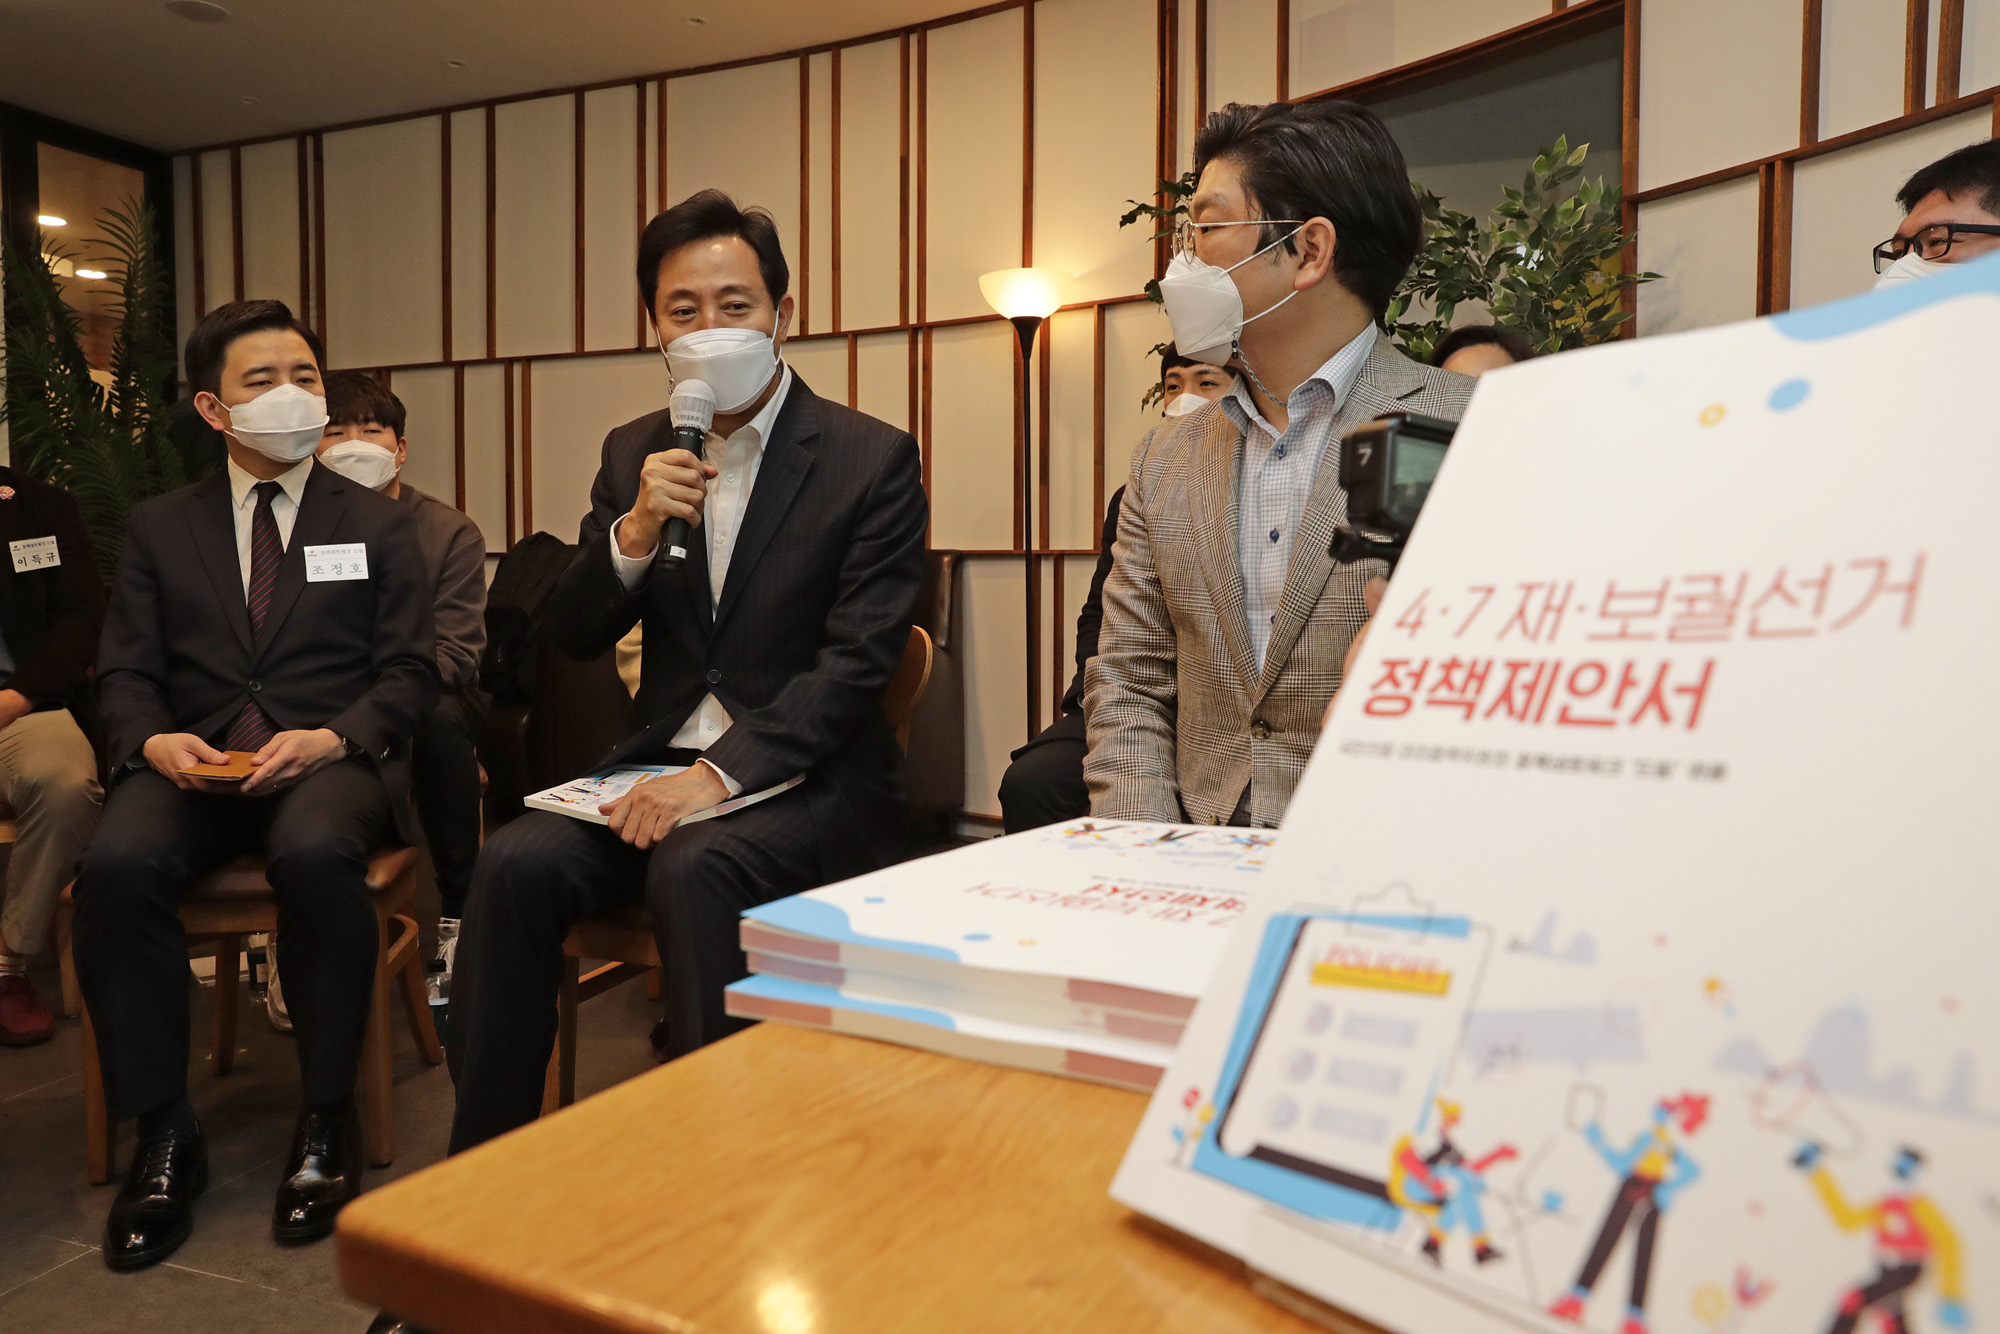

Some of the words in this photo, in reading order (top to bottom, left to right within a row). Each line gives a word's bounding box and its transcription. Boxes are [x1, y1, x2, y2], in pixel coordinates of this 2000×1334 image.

[1357, 446, 1374, 467] 7
[311, 562, 363, 576] 조정호
[1393, 585, 1497, 641] 4·7
[1496, 552, 1928, 645] 재·보궐선거
[1361, 654, 1719, 733] 정책제안서
